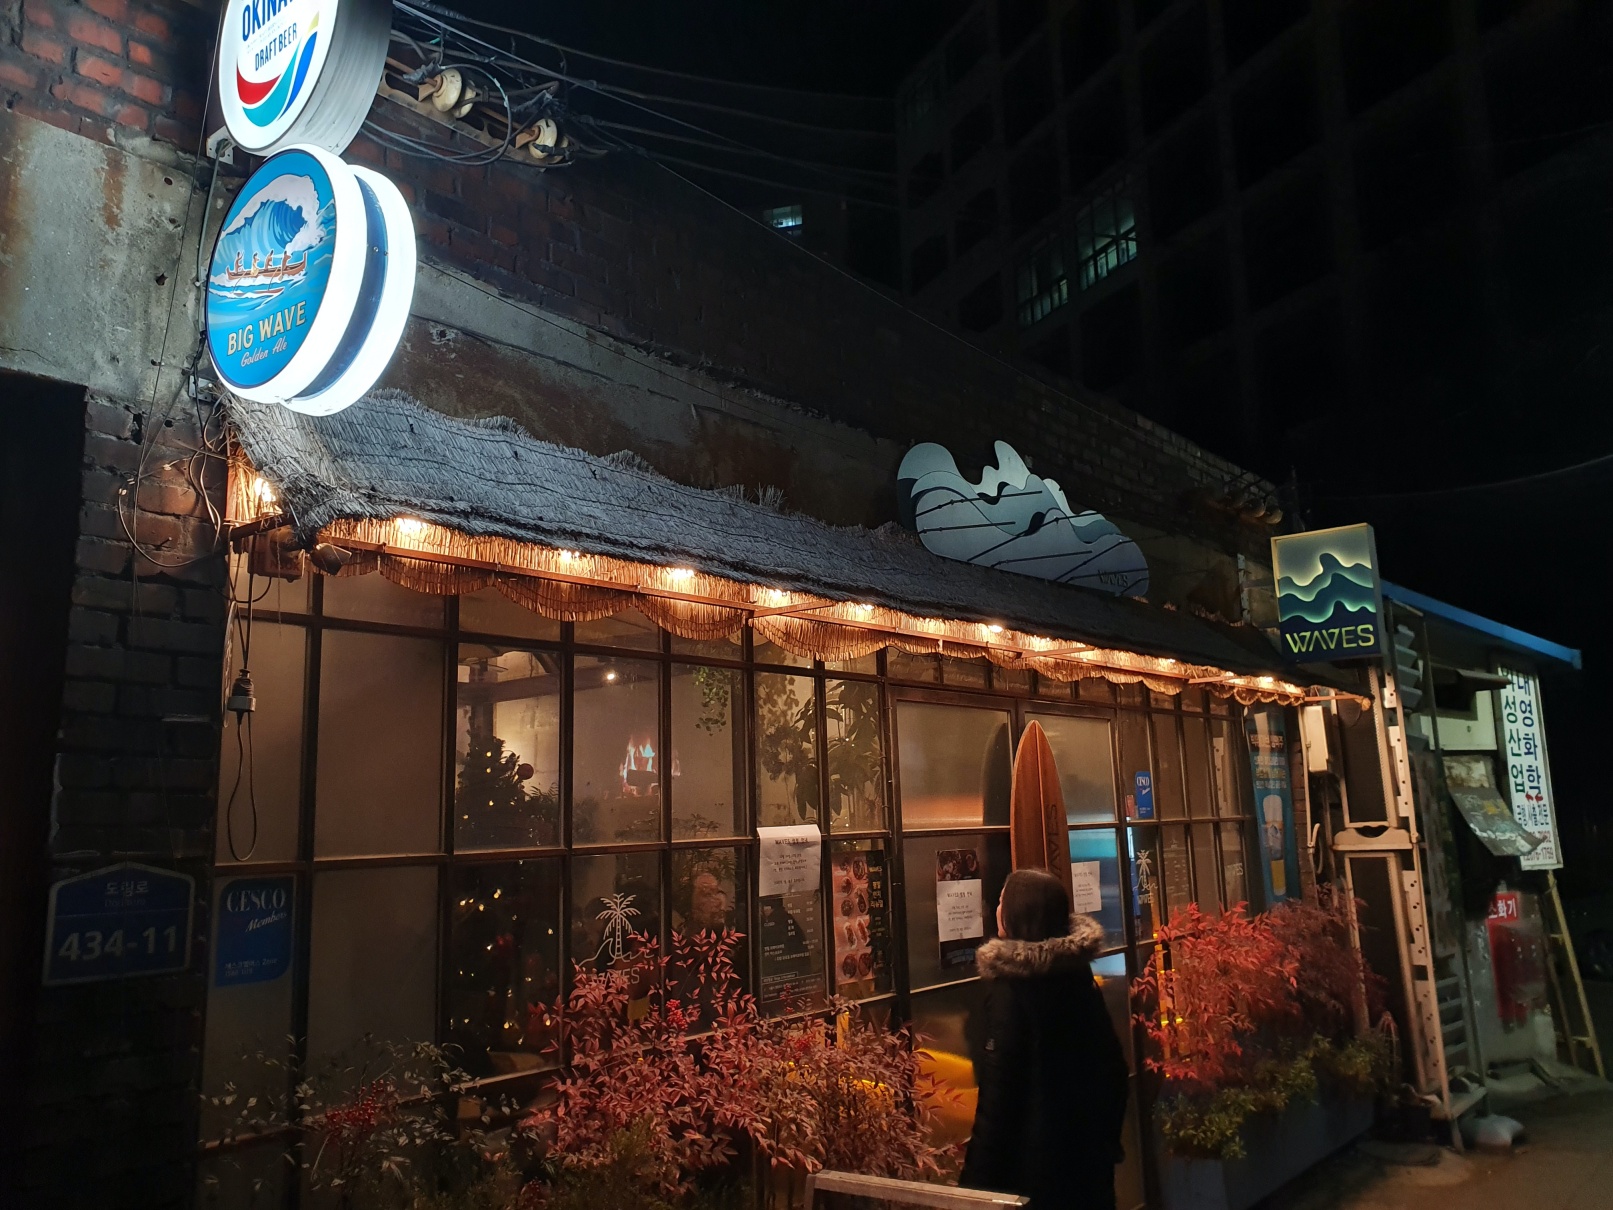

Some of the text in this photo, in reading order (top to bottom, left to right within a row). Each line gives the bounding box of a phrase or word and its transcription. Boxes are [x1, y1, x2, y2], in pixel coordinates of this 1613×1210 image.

[255, 38, 277, 71] DRAFT
[279, 23, 297, 52] BEER
[227, 300, 306, 356] BIG WAVE
[241, 336, 288, 367] Golden Ale
[1285, 624, 1375, 654] WAVES
[226, 888, 287, 912] CESCO
[245, 911, 288, 932] Members
[58, 926, 177, 961] 434-11
